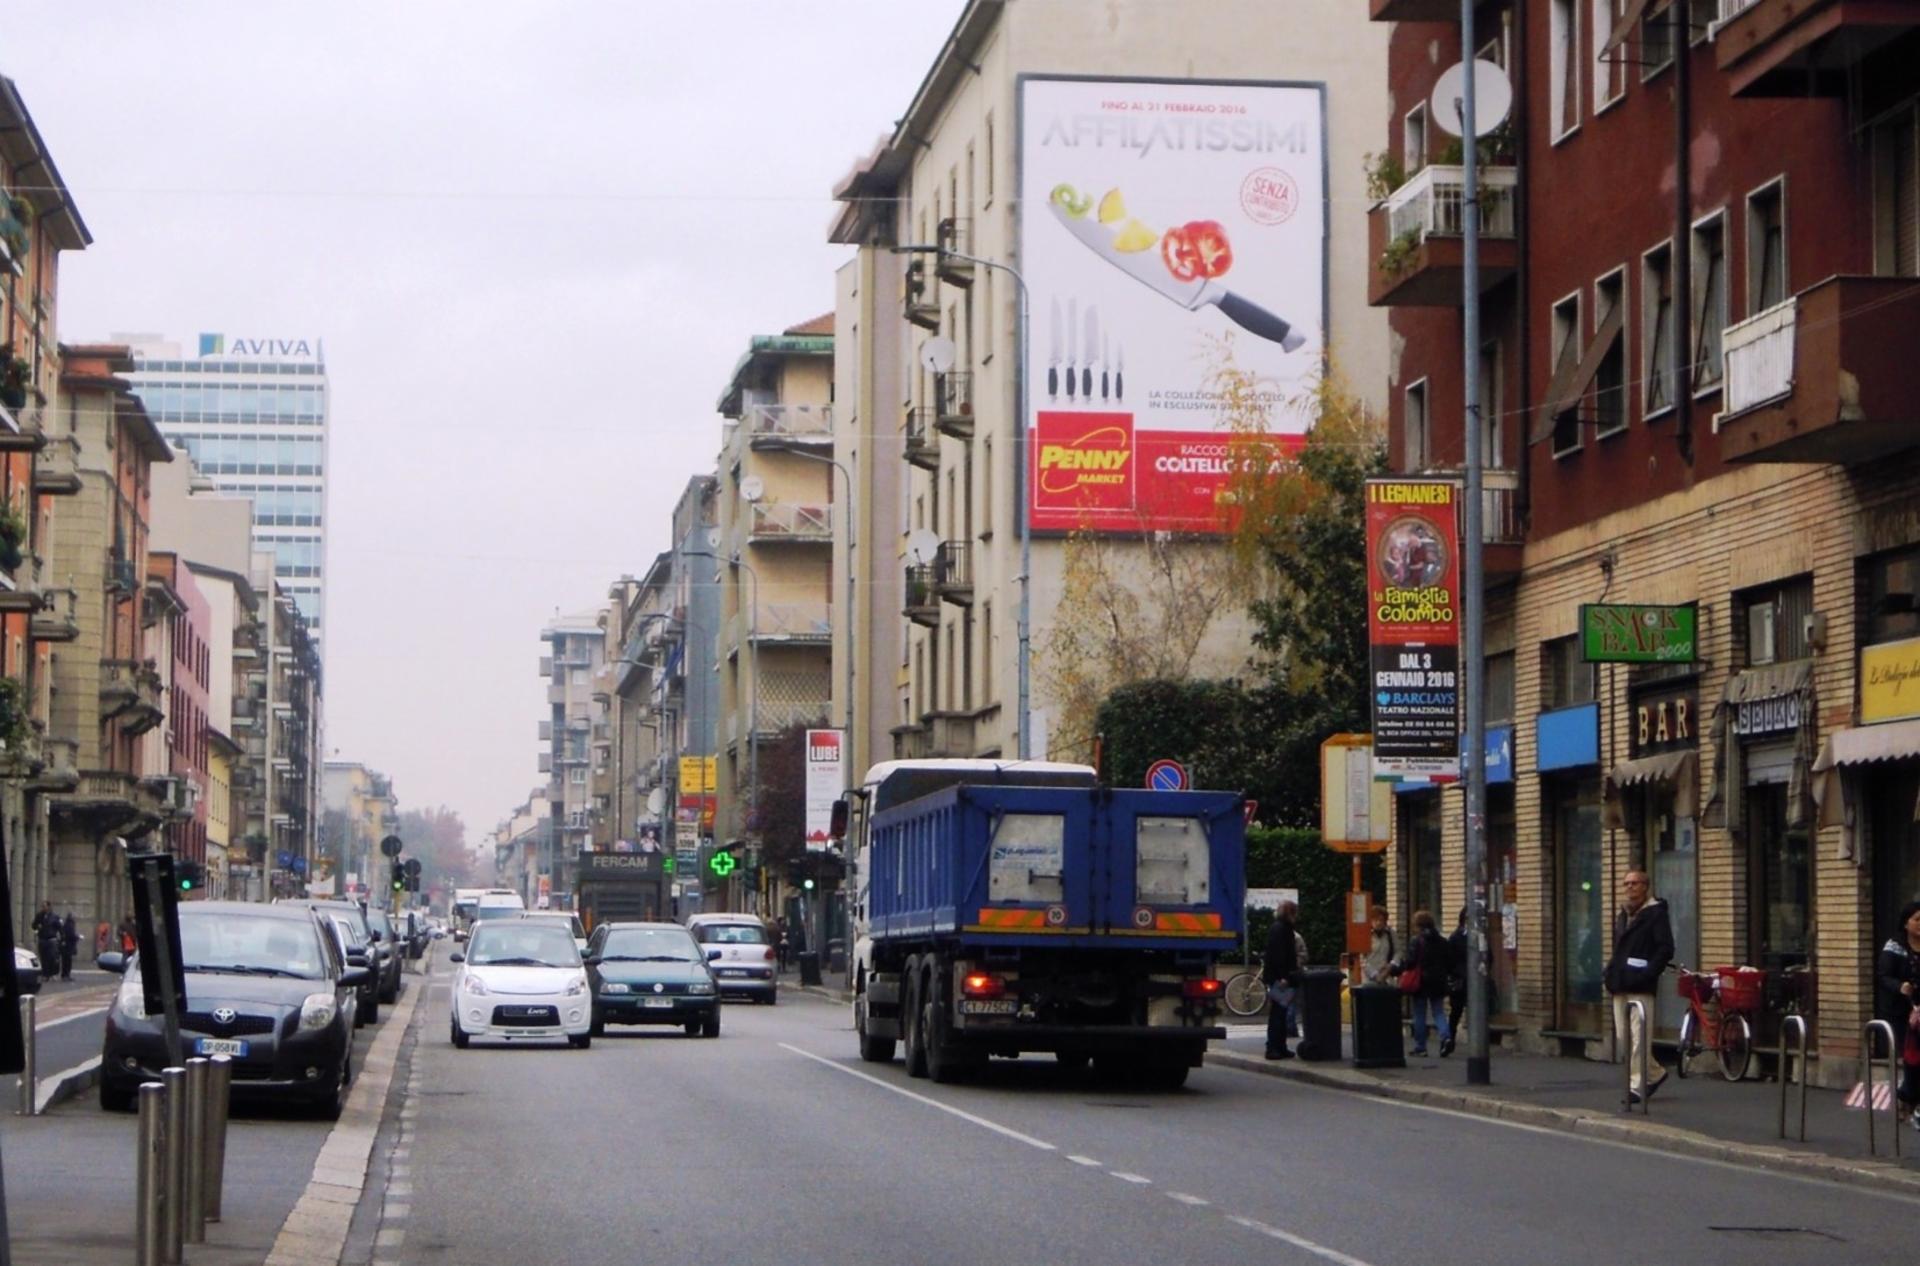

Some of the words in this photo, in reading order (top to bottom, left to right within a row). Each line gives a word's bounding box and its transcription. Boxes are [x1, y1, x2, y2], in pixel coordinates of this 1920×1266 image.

[1101, 101, 1129, 111] FINO
[1131, 103, 1145, 112] AL
[1164, 103, 1217, 113] FEBBRAIO
[1219, 104, 1247, 115] 2016
[1041, 115, 1308, 158] AFFILATISSIMI
[1252, 176, 1289, 201] SENZA
[231, 338, 311, 356] AVIVA
[1040, 445, 1131, 470] PENNY
[1077, 474, 1125, 485] MARKET
[1380, 484, 1450, 504] LEGNANESI
[1385, 586, 1449, 606] Famiglia
[1377, 603, 1454, 623] Colombo
[1656, 641, 1691, 660] 2000
[1399, 653, 1421, 669] DAL
[1423, 653, 1432, 669] 3
[1376, 671, 1425, 688] GENNAIO
[1427, 671, 1455, 688] 2016
[1393, 692, 1455, 704] BARCLAYS
[1377, 706, 1409, 715] TEATRO
[1410, 706, 1455, 715] NAZIONALE
[1739, 693, 1798, 733] SEIKO
[1637, 698, 1689, 746] BAR
[810, 745, 839, 761] LUBE
[592, 855, 648, 869] FERCAM
